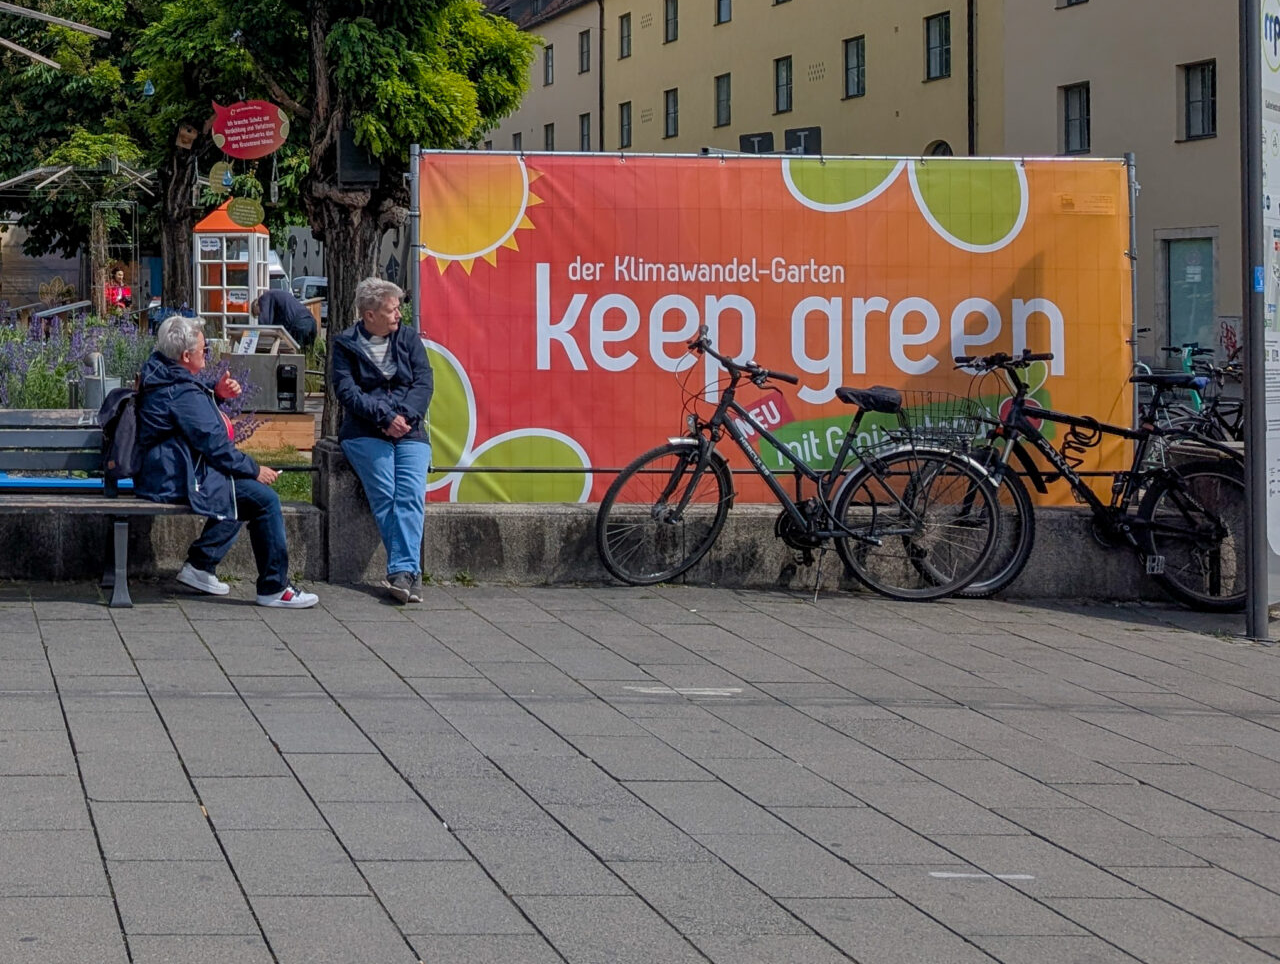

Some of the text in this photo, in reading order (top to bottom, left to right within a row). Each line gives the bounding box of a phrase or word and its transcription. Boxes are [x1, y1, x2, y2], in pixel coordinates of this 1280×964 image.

[568, 255, 845, 284] der Klimawandel-Garten
[536, 262, 1066, 405] keep green
[734, 400, 781, 439] NEU
[739, 436, 770, 476] HERCULES
[777, 430, 823, 467] mit
